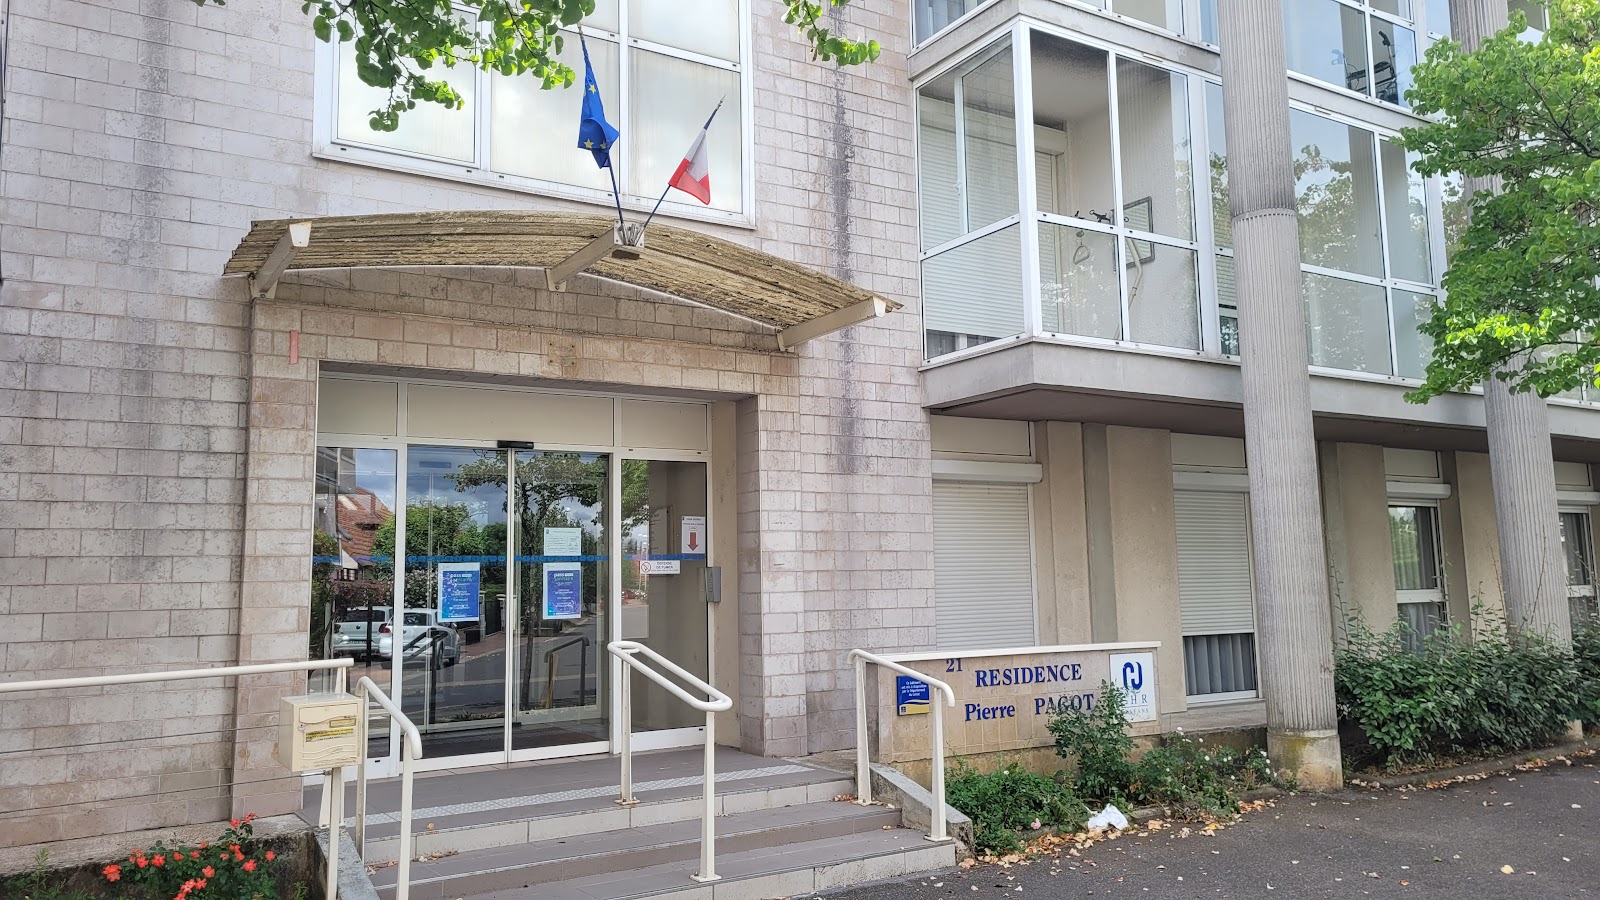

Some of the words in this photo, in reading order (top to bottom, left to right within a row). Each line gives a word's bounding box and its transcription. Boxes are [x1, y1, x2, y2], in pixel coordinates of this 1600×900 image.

[946, 658, 963, 672] 21
[974, 664, 1082, 688] RESIDENCE
[964, 703, 1016, 722] Pierre
[1034, 694, 1094, 715] PAGOT
